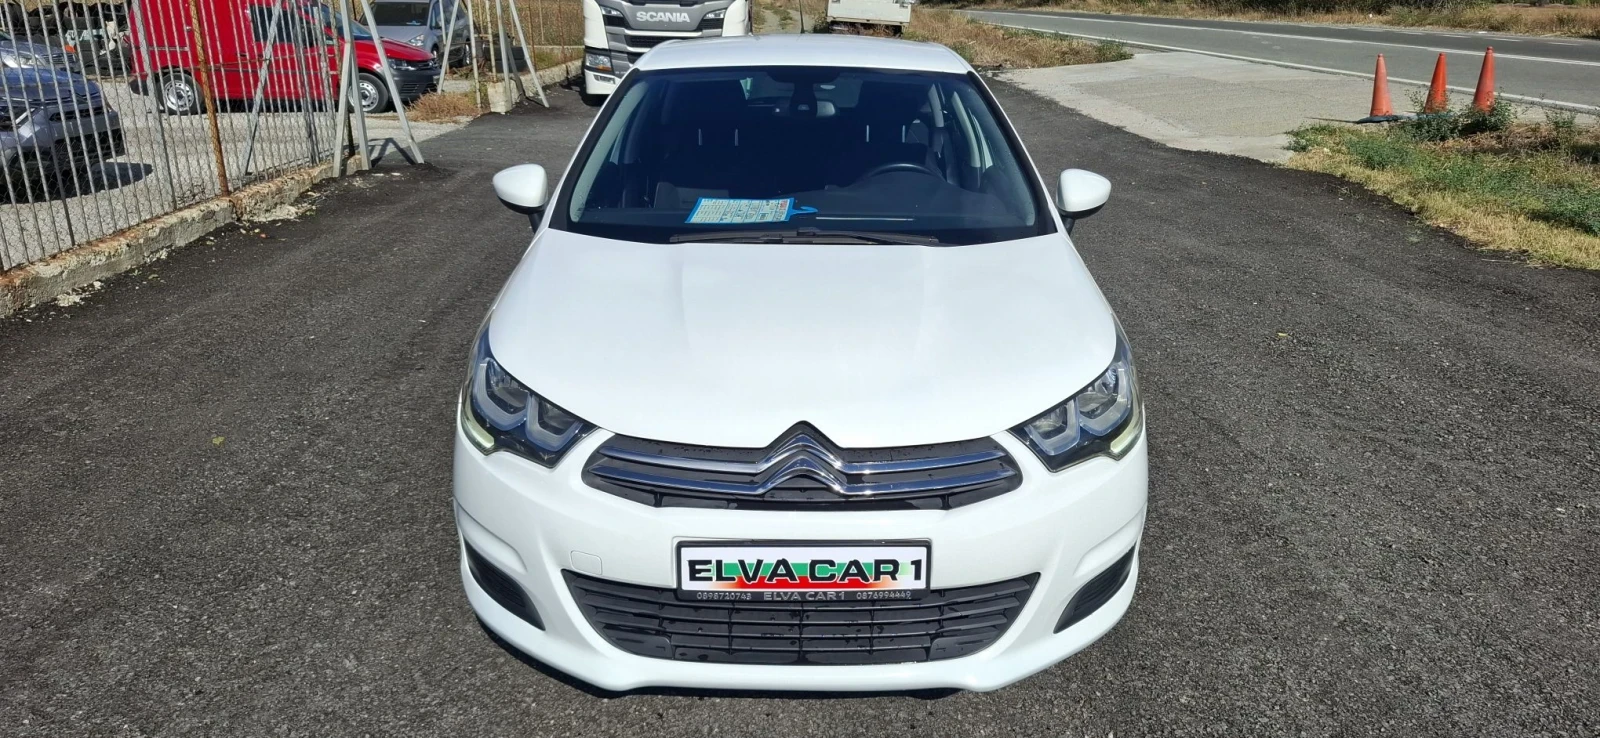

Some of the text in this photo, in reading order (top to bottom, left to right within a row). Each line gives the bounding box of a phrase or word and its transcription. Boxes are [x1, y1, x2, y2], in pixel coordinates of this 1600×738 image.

[636, 11, 691, 23] SCANIA
[688, 558, 922, 583] ELVA CAR 1
[763, 591, 801, 601] ELVA
[856, 591, 911, 600] 0876994449
